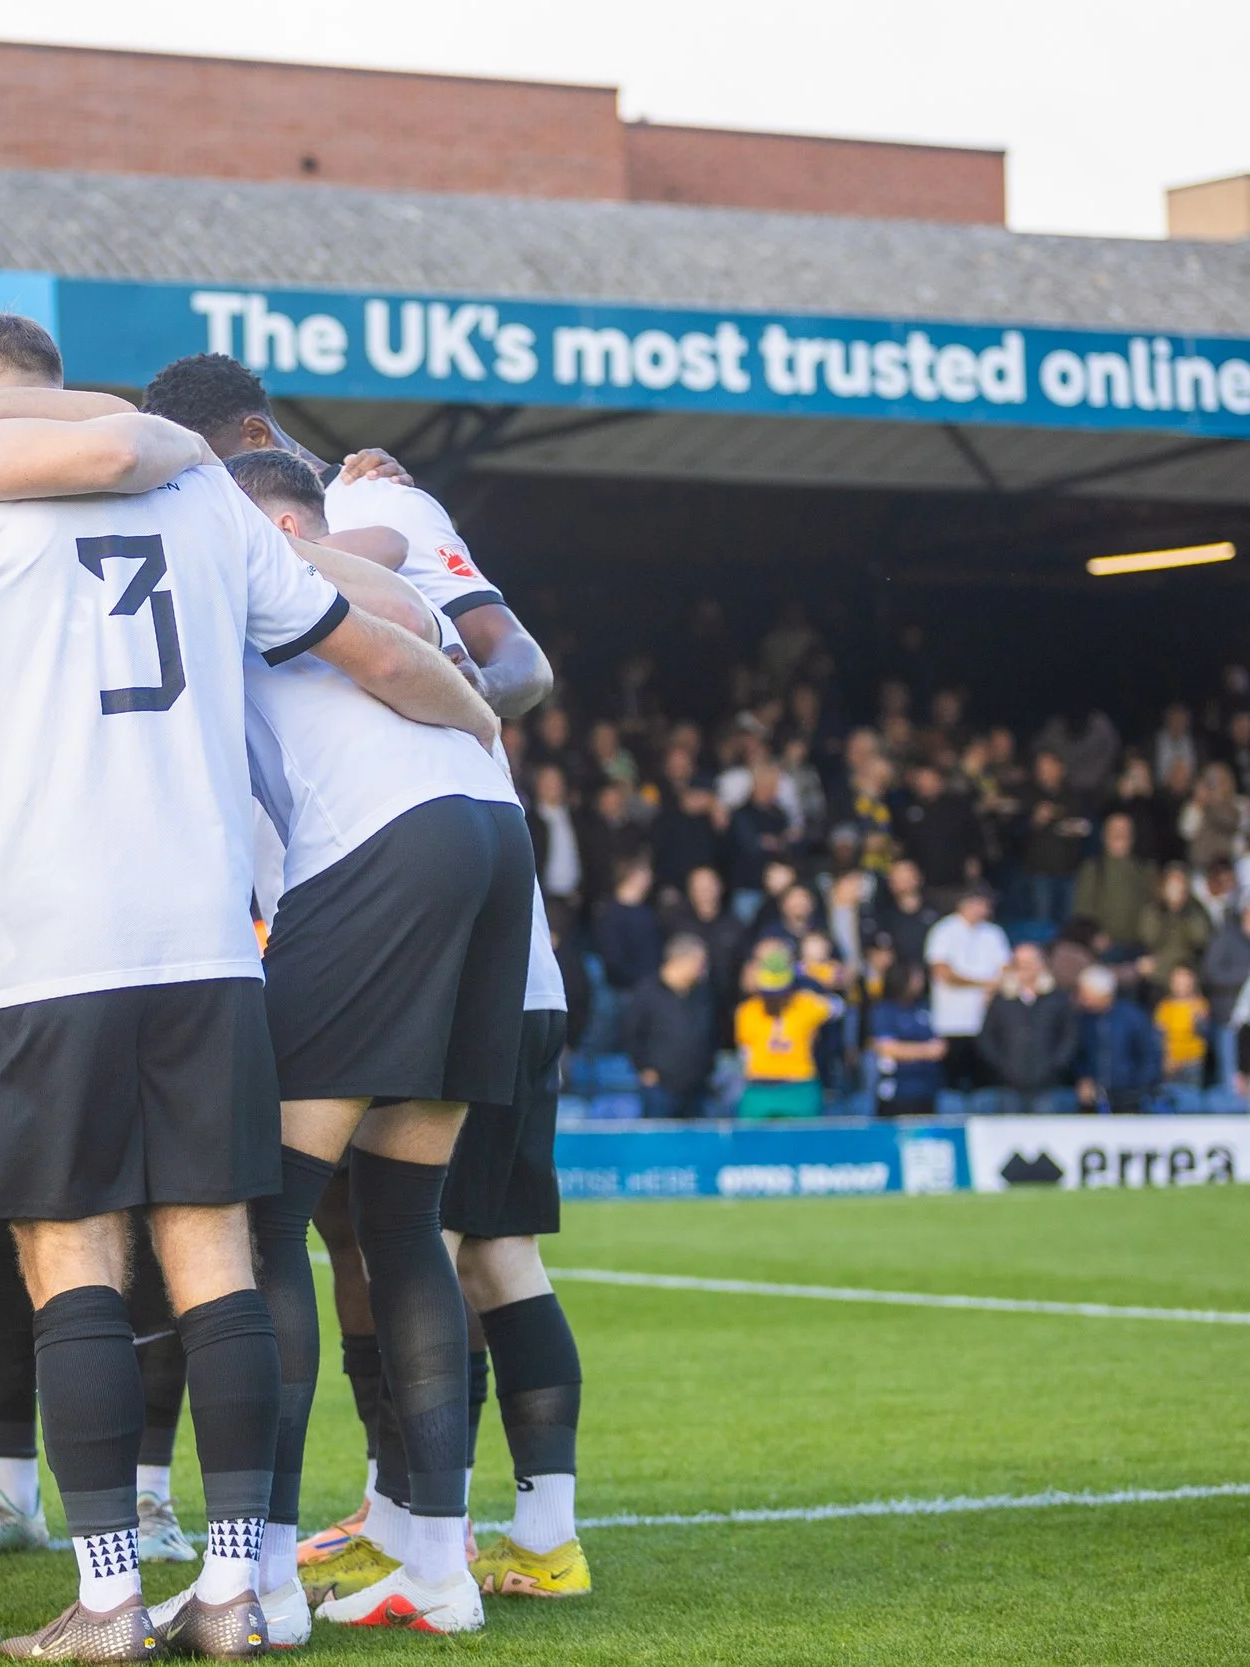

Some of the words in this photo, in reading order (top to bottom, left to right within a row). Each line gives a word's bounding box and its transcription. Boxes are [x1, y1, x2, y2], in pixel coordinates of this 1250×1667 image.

[191, 290, 348, 376] The
[364, 299, 538, 384] UK's
[553, 321, 749, 393] most
[760, 324, 1027, 405] trusted
[1040, 336, 1250, 416] online
[75, 534, 186, 715] 3
